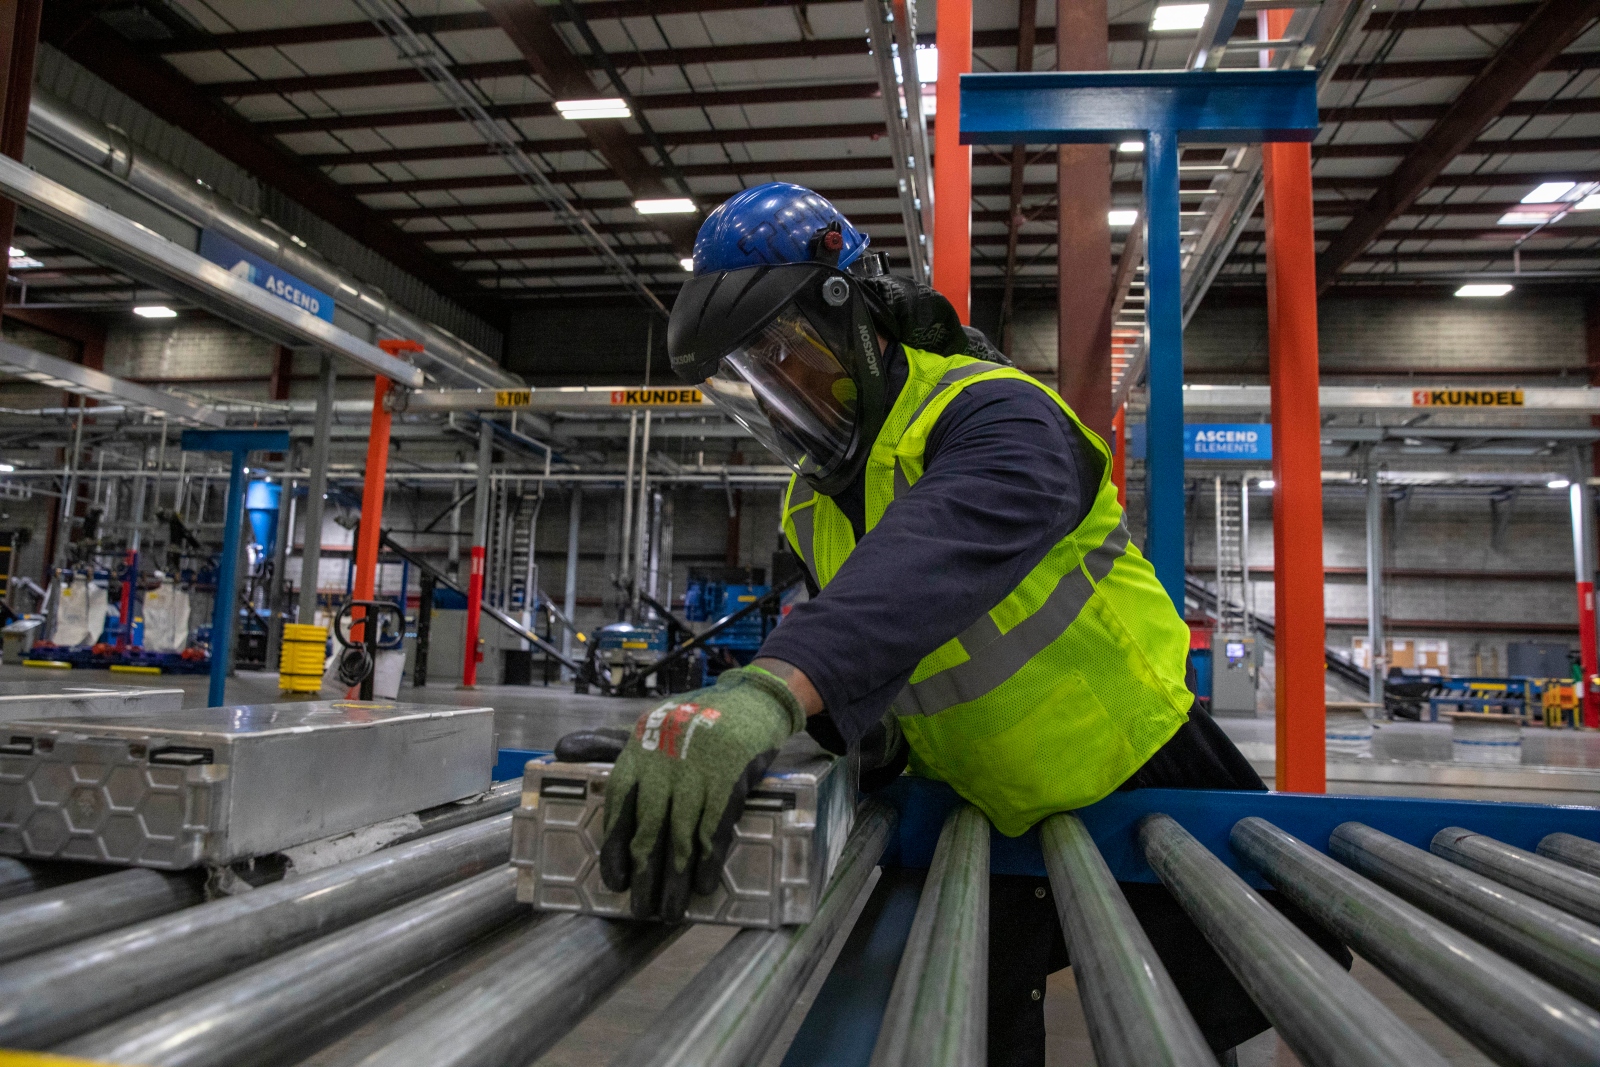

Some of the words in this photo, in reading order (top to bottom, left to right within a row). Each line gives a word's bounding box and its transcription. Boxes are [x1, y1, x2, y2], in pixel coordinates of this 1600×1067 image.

[265, 274, 320, 314] ASCEND
[858, 324, 880, 377] JACKSON
[507, 391, 530, 405] TON
[625, 391, 702, 404] KUNDEL
[1431, 391, 1523, 405] KUNDEL
[1195, 430, 1259, 442] ASCEND
[1194, 442, 1259, 454] ELEMENTS
